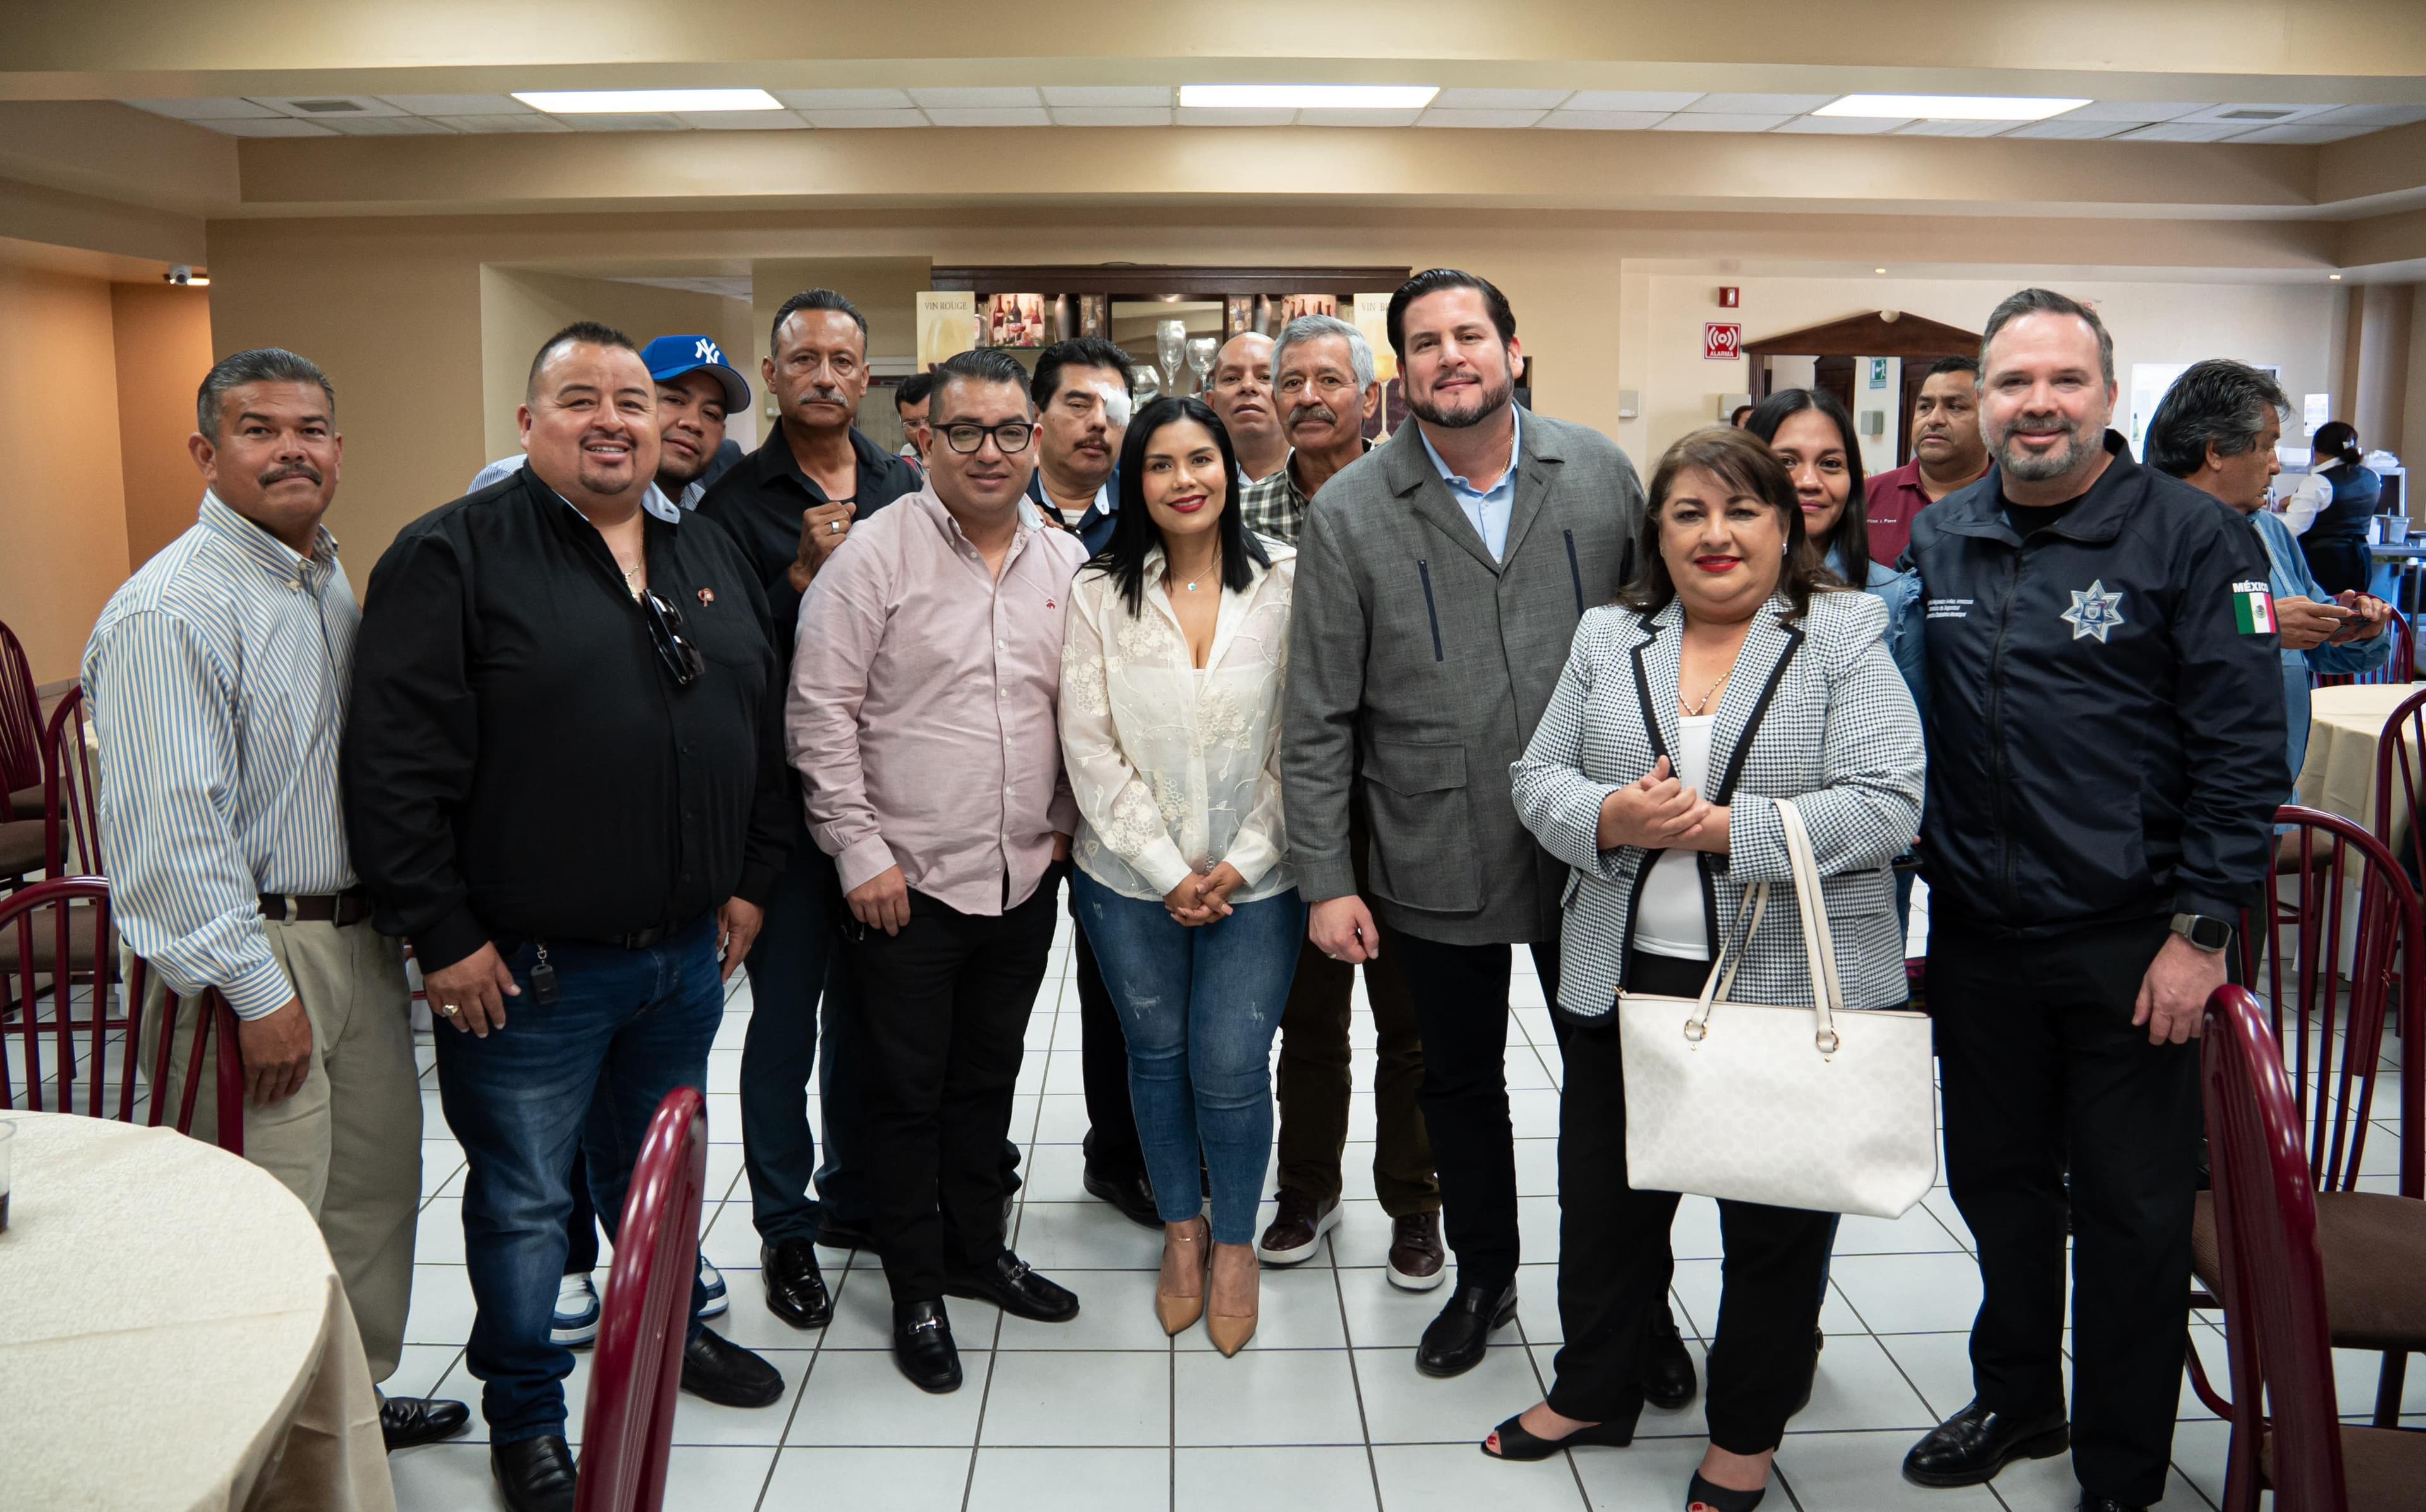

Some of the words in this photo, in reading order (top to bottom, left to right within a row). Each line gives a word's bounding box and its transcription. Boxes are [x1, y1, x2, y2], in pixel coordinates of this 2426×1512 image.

[924, 302, 938, 310] VIN
[939, 301, 967, 310] ROUGE
[1361, 303, 1375, 311] VIN
